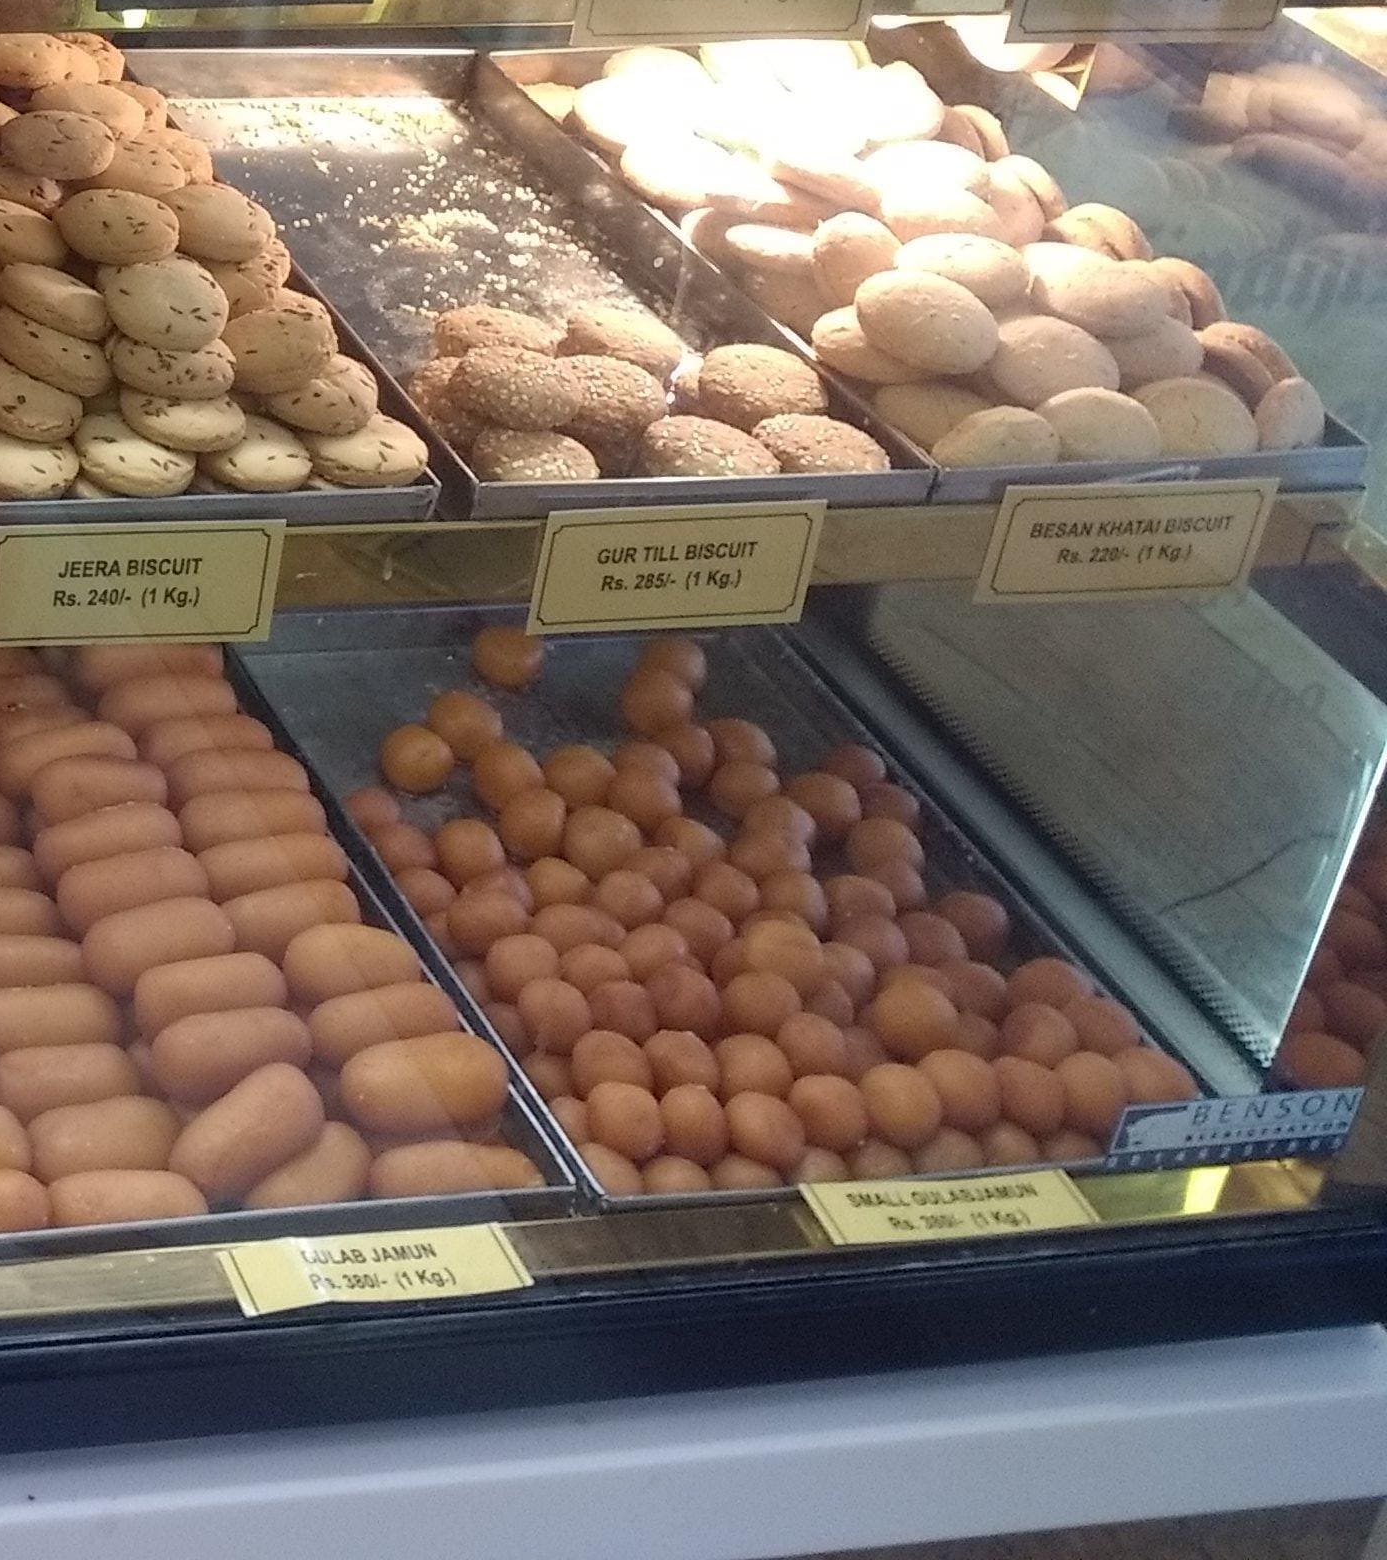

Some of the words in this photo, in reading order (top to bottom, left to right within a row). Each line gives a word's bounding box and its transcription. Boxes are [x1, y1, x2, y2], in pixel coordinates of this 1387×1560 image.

[1030, 522, 1093, 539] BESAN
[1097, 519, 1160, 537] KHATAI
[1165, 516, 1233, 535] BISCUIT
[597, 547, 637, 564] GUR
[643, 544, 679, 562] TILL
[685, 542, 757, 560] BISCUIT
[1057, 548, 1083, 563] Rs.
[59, 560, 121, 578] JEERA
[127, 558, 202, 576] BISCUIT
[602, 575, 627, 591] Rs.
[635, 572, 676, 589] 285/-
[685, 571, 701, 590] (1
[706, 569, 742, 590] Kg.)
[53, 590, 80, 607] Rs.
[88, 589, 131, 606] 240/-
[142, 589, 157, 608] (1
[164, 587, 200, 607] Kg.)
[1192, 1094, 1357, 1125] BENSON
[846, 1192, 910, 1208] SMALL
[301, 1249, 367, 1265] GULAB
[371, 1244, 437, 1263] JAMUN
[395, 1270, 412, 1290] (1
[419, 1268, 456, 1287] Kg.)
